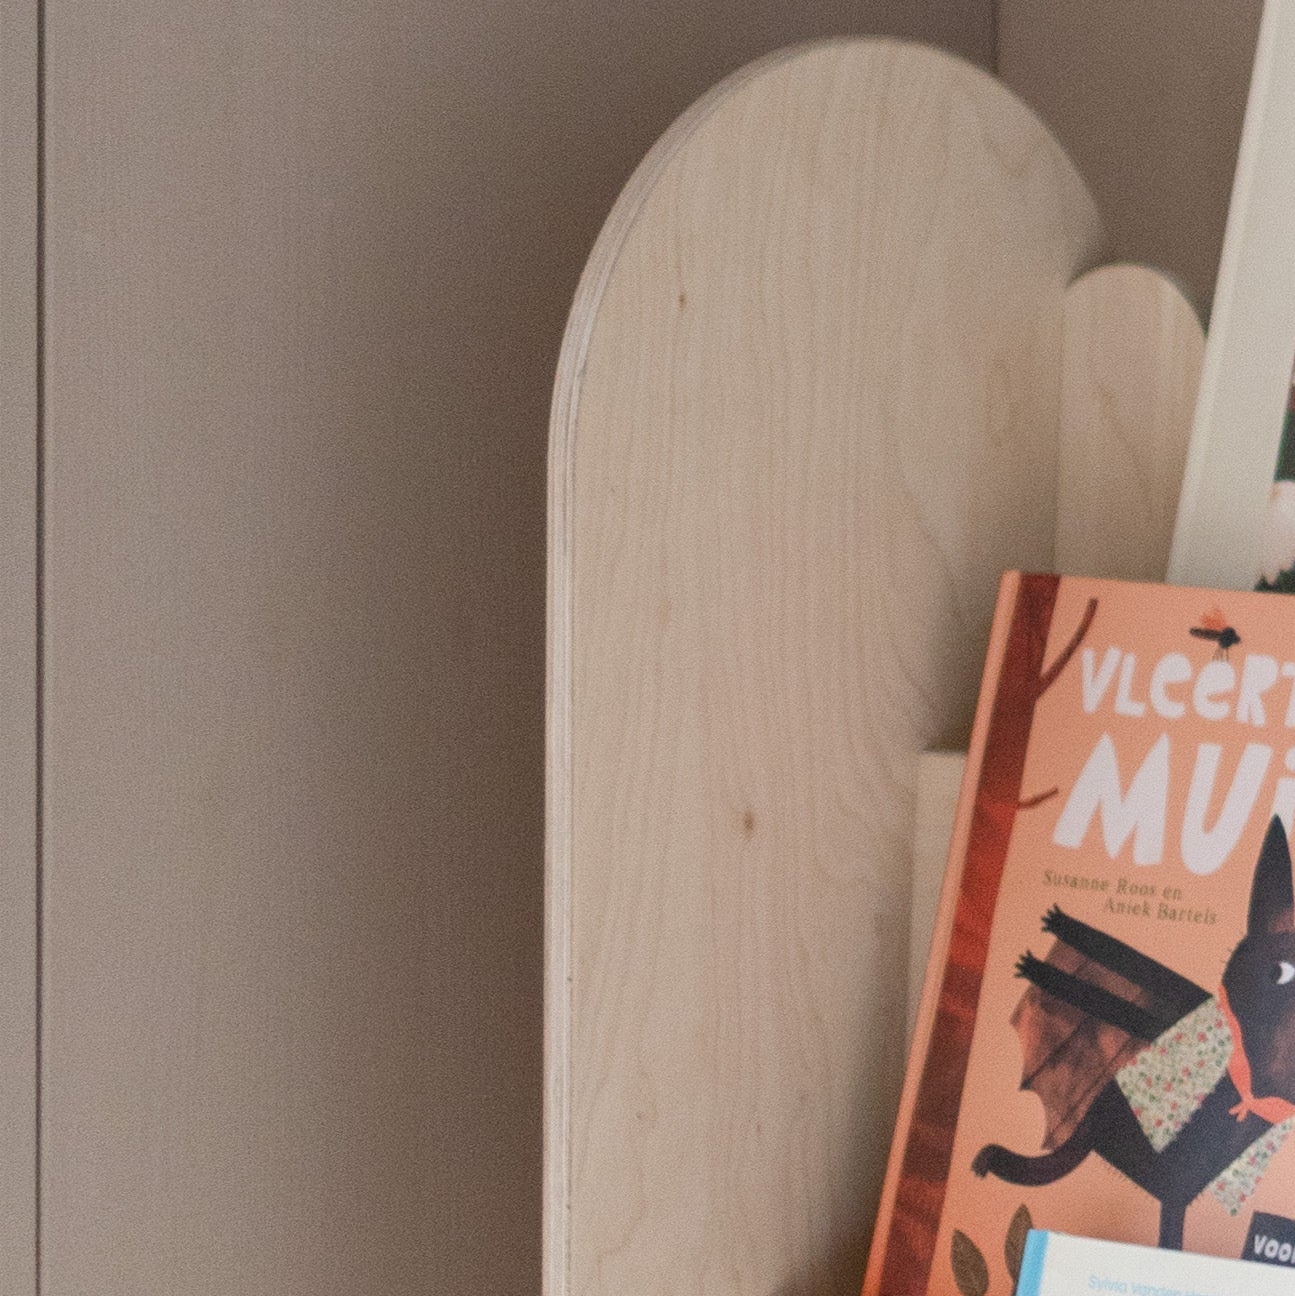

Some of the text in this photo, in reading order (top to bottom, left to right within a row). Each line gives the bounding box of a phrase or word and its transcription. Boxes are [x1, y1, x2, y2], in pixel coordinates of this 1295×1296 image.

[1042, 869, 1183, 902] Susanne Roos en
[1102, 895, 1218, 926] Aniek Bartels
[1088, 1274, 1128, 1295] Sylvia
